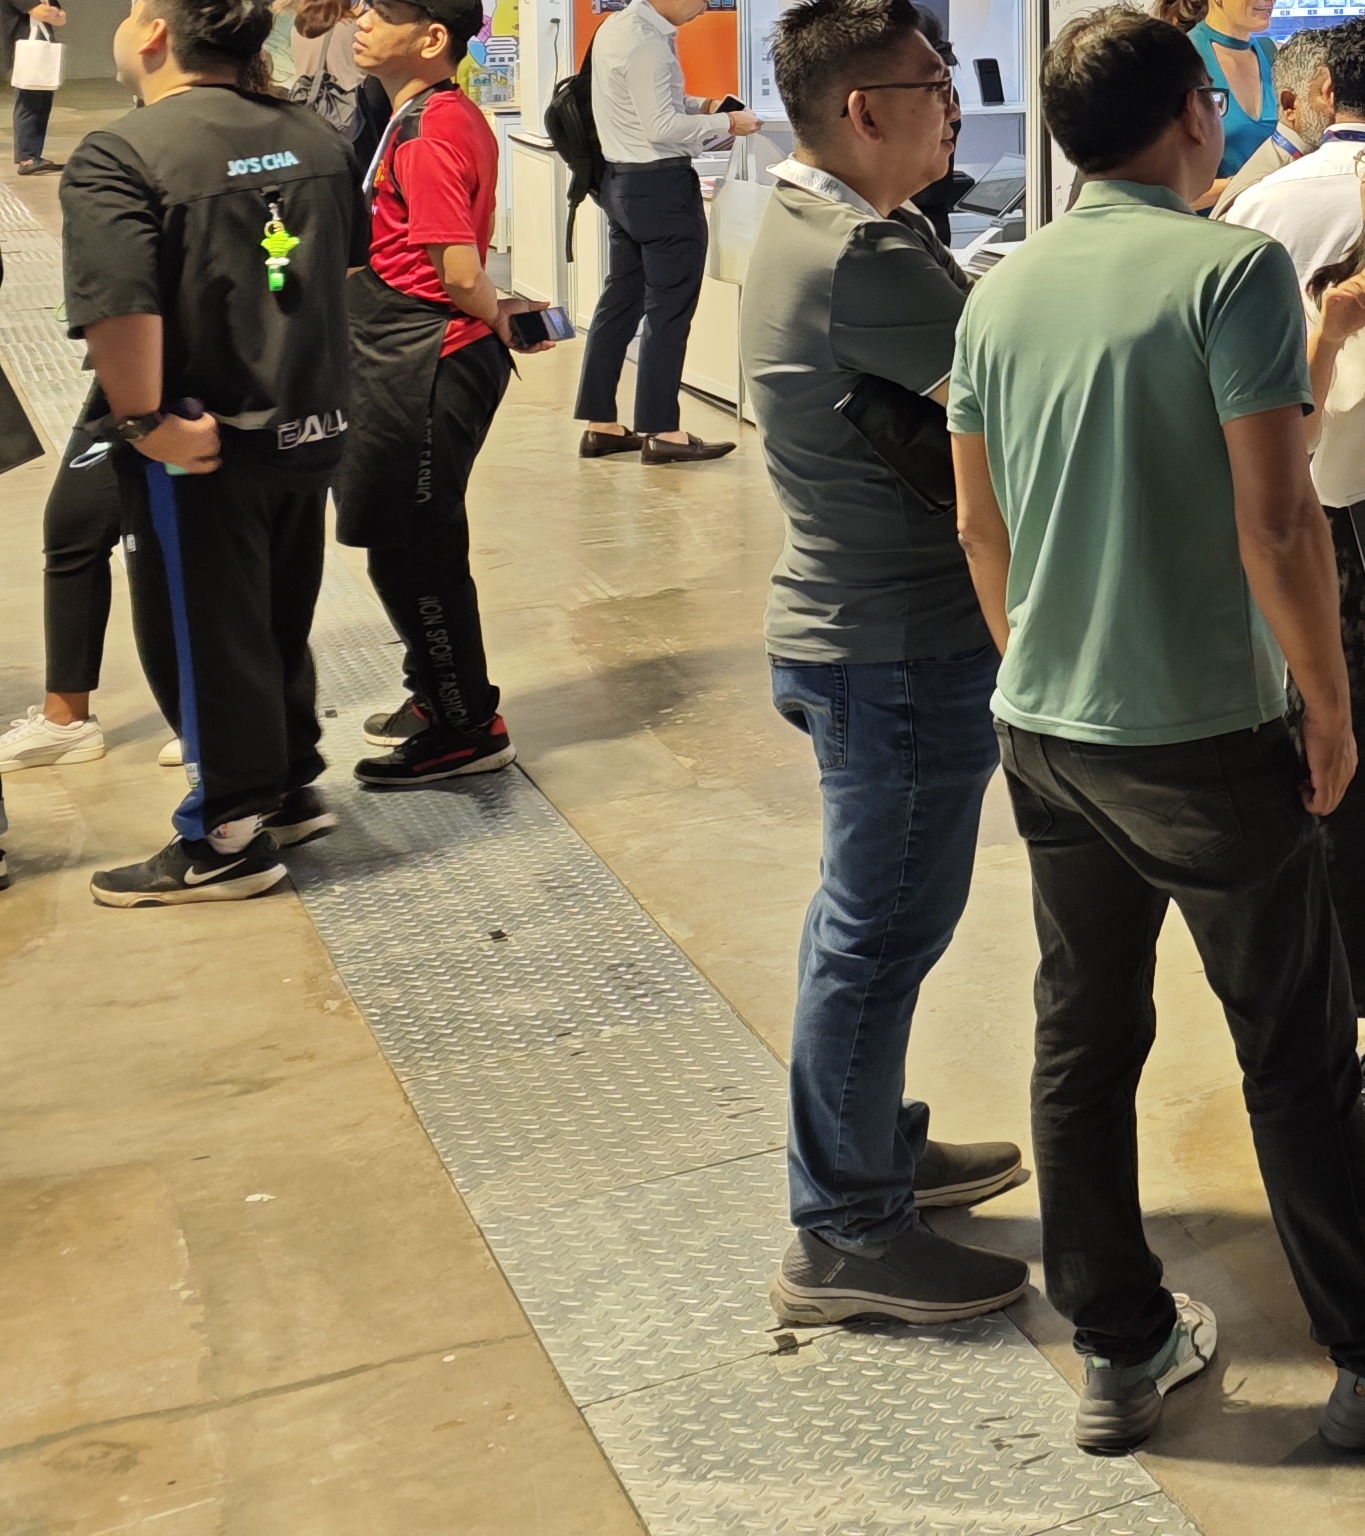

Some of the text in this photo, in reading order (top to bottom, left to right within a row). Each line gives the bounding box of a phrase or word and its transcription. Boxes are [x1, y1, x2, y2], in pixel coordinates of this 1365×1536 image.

[226, 150, 301, 177] JO'S CHA
[425, 627, 455, 669] SPORT
[436, 671, 472, 728] FASHION
